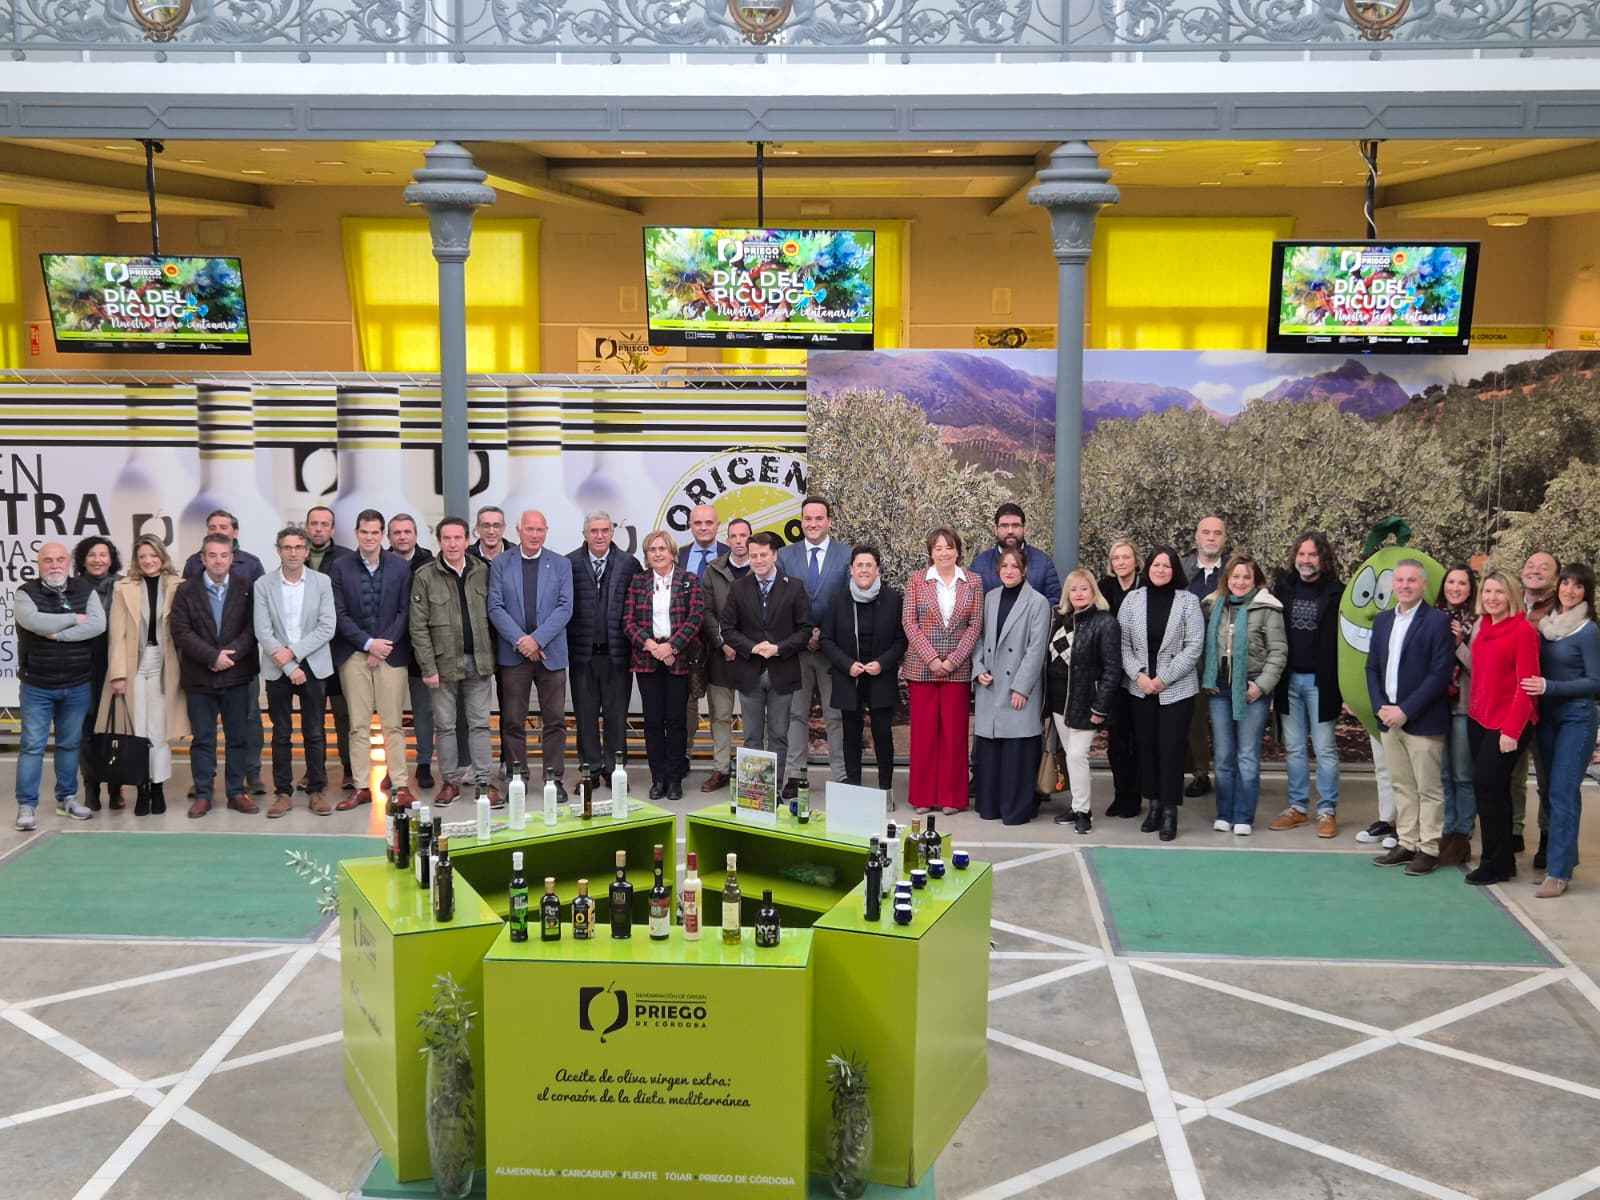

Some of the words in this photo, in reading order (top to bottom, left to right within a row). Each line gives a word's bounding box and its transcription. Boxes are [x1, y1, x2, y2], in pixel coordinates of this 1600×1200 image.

[713, 267, 754, 287] DÍA
[760, 271, 804, 287] DEL
[1334, 275, 1366, 293] DÍA
[1372, 279, 1406, 294] DEL
[104, 286, 142, 303] DÍA
[145, 289, 187, 304] DEL
[714, 287, 801, 304] PICUDO
[1333, 294, 1404, 310] PICUDO
[105, 303, 186, 318] PICUDO
[715, 302, 760, 317] Nuestro
[1333, 310, 1370, 322] Nuestro
[111, 316, 150, 329] Nuestro
[0, 453, 43, 493] N
[666, 455, 807, 531] ORIGEN
[635, 1004, 708, 1020] PRIEGO
[555, 1068, 597, 1082] Aceite
[598, 1068, 615, 1083] de
[617, 1068, 648, 1084] oliva
[650, 1073, 690, 1091] virgen
[692, 1072, 731, 1087] extra:
[537, 1086, 549, 1101] el
[551, 1089, 598, 1103] corazón
[600, 1088, 616, 1103] de
[618, 1088, 631, 1104] la
[633, 1089, 665, 1105] dieta
[669, 1090, 751, 1108] mediterránea
[622, 1170, 658, 1181] FUENTE
[699, 1173, 733, 1184] PRIEGO
[735, 1174, 747, 1184] DE
